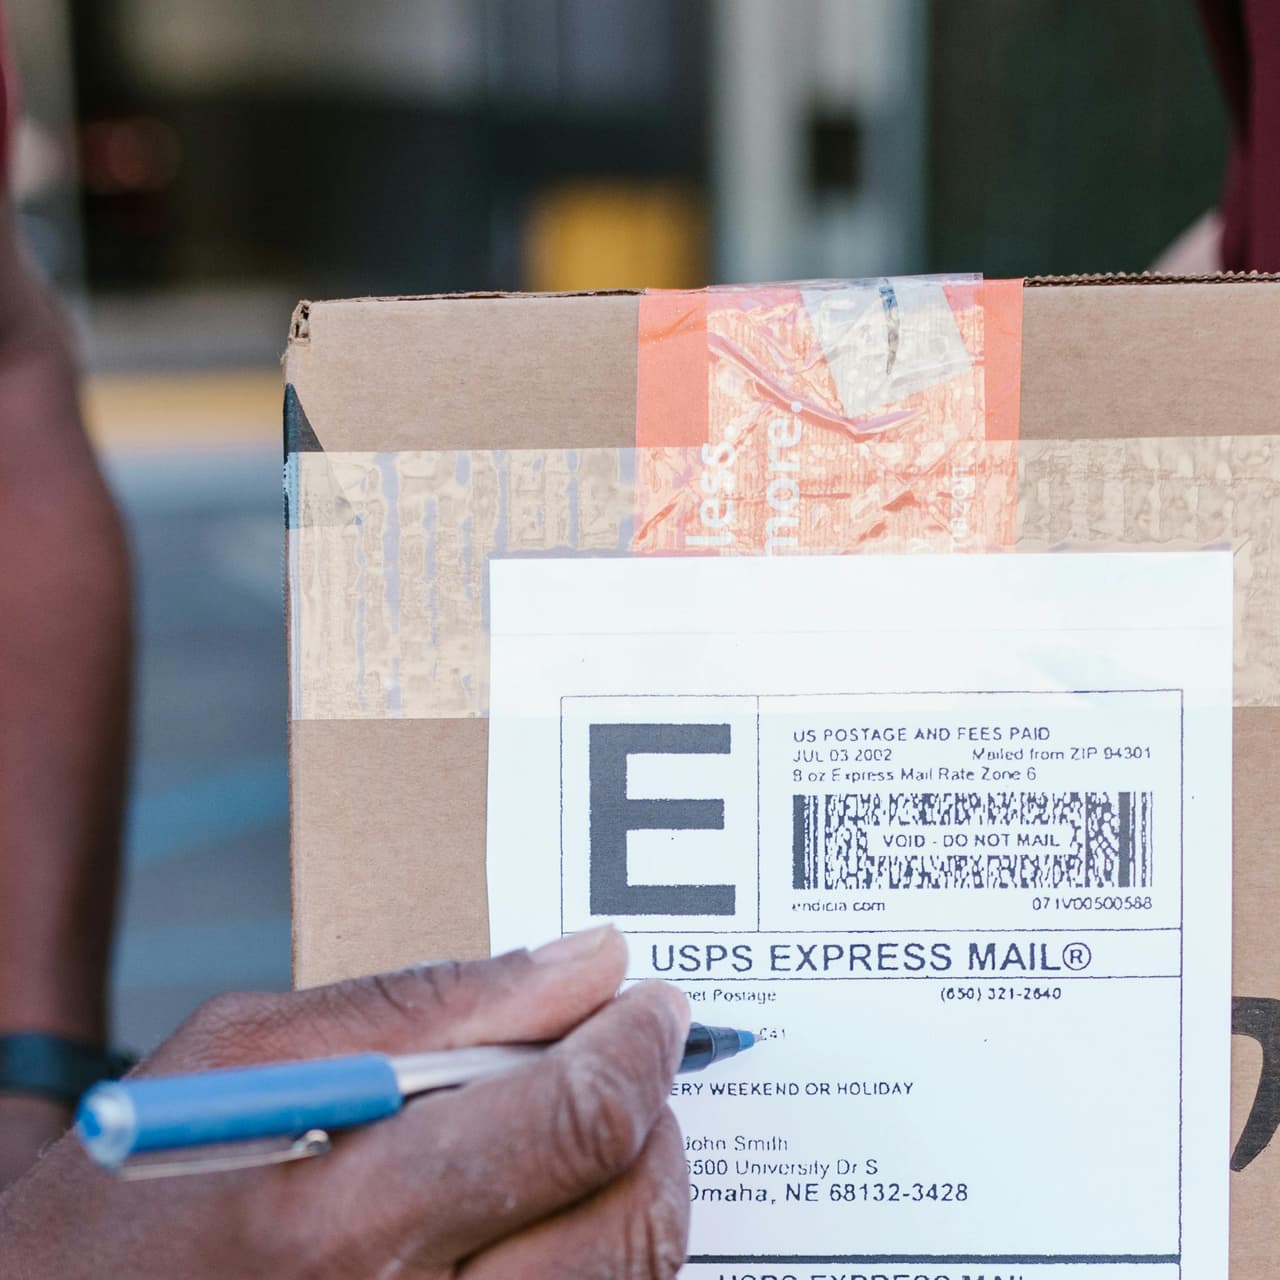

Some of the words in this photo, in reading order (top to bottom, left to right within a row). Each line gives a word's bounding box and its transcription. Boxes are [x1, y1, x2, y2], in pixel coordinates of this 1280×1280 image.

[686, 426, 737, 548] less.
[950, 466, 973, 555] mazon
[793, 729, 817, 743] US
[823, 727, 907, 742] POSTAGE
[913, 727, 951, 742] AND
[957, 726, 1003, 742] FEES
[1009, 726, 1051, 741] PAID
[792, 749, 824, 763] JUL
[829, 748, 849, 762] 03
[854, 747, 893, 762] 2002
[972, 747, 1024, 761] Mailed
[1029, 747, 1065, 761] from
[1070, 746, 1098, 761] ZIP
[1103, 745, 1151, 760] 94301
[792, 768, 803, 782] 8
[807, 771, 826, 782] oz
[831, 767, 894, 784] Express
[900, 767, 933, 782] Mail
[938, 767, 975, 781] Rate
[981, 765, 1022, 781] Zone
[1026, 766, 1037, 781] 6
[588, 722, 737, 917] E
[882, 834, 926, 849] VOID
[943, 833, 969, 848] DO
[974, 833, 1011, 848] NOT
[1016, 833, 1061, 848] MAIL
[651, 944, 753, 973] USPS
[769, 942, 953, 972] EXPRESS
[713, 988, 777, 1005] Postage
[670, 1082, 704, 1097] ERY
[709, 1081, 800, 1097] WEEKEND
[804, 1082, 831, 1096] OR
[836, 1081, 914, 1096] HOLIDAY
[684, 1134, 728, 1152] John
[734, 1135, 788, 1152] Smith
[735, 1159, 830, 1180] University
[836, 1159, 858, 1175] Dr
[865, 1158, 879, 1176] S
[785, 1182, 819, 1202] NE
[829, 1182, 968, 1202] 68132-3428
